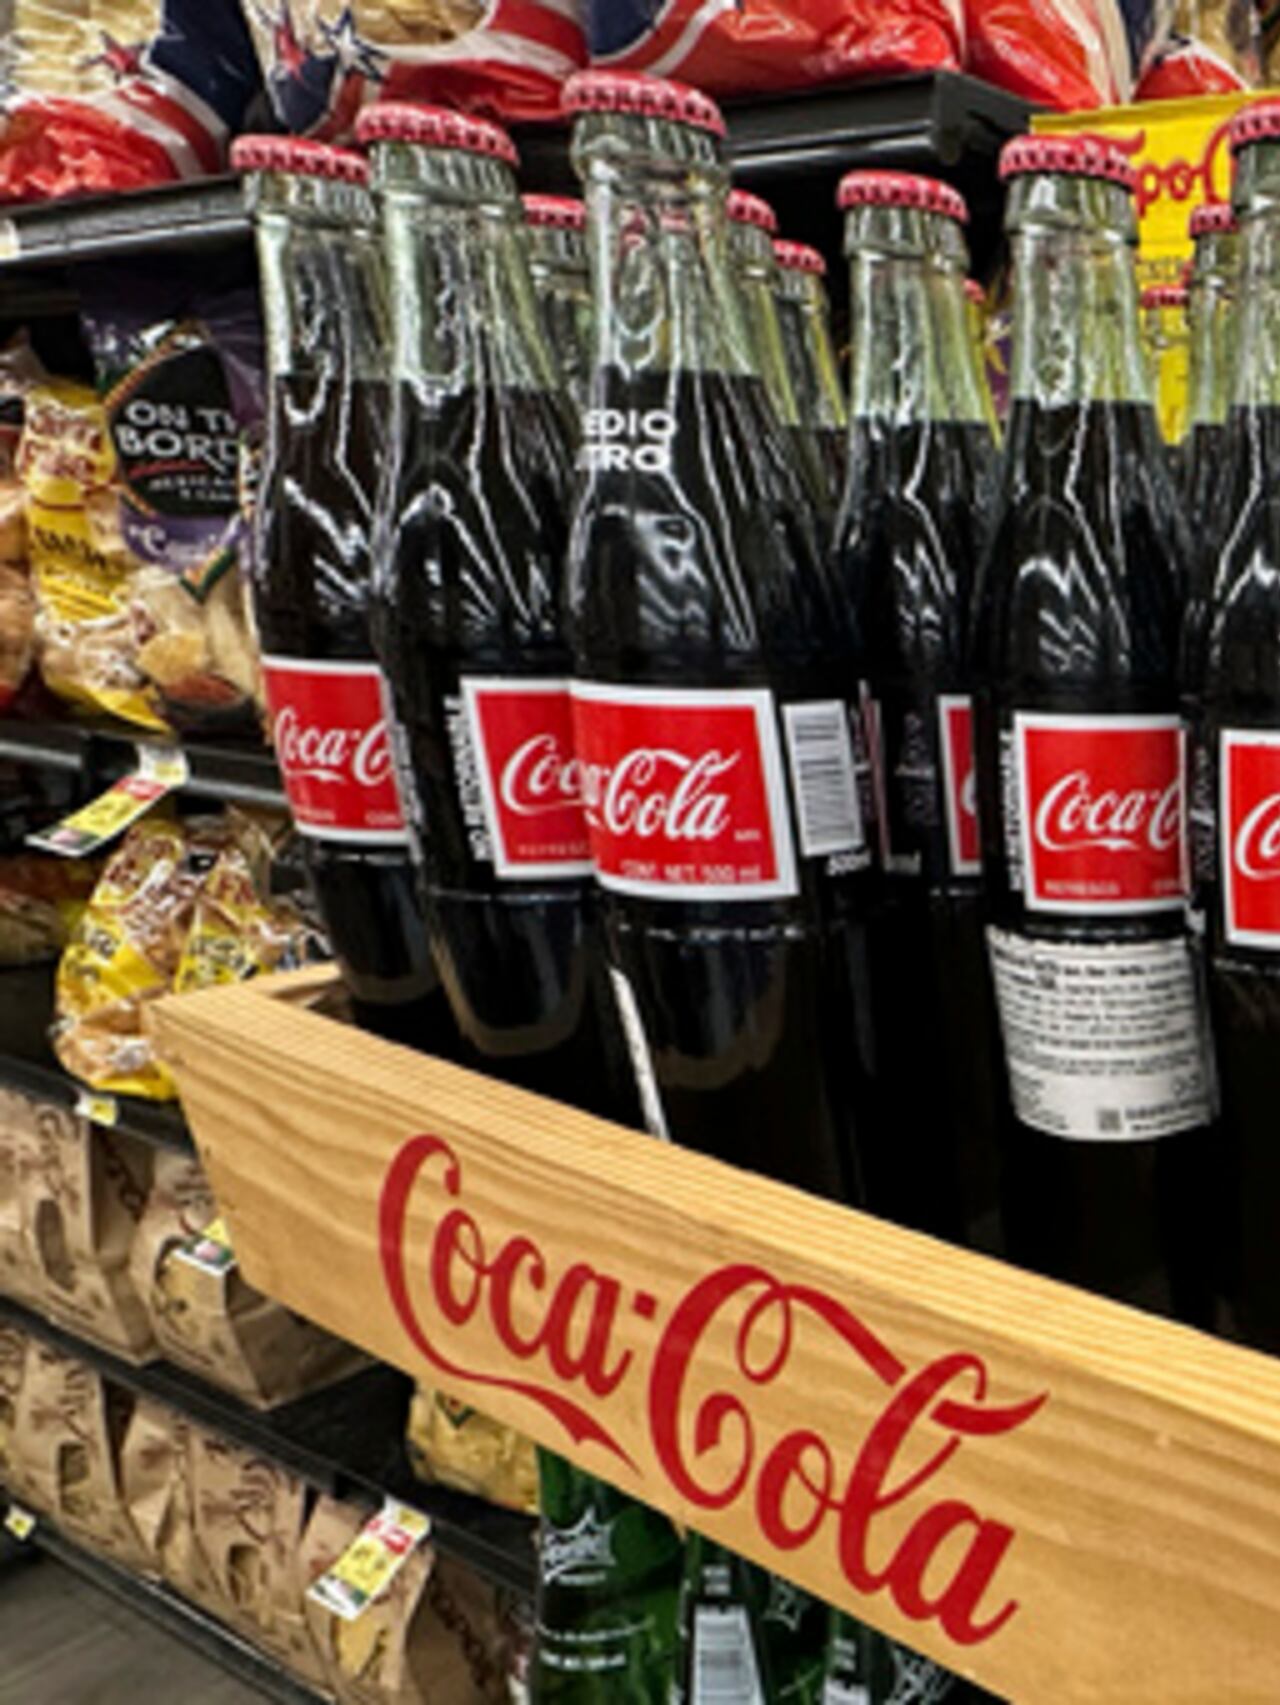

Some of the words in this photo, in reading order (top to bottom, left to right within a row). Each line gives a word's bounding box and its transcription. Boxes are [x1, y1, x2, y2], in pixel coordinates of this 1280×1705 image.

[126, 401, 190, 430] ON
[582, 408, 676, 438] EDIO
[116, 424, 241, 474] BORD
[574, 443, 671, 472] TRO
[275, 706, 396, 788] Coca-C
[1035, 770, 1182, 851] Coca-C
[379, 1134, 1050, 1645] Coca-Cola
